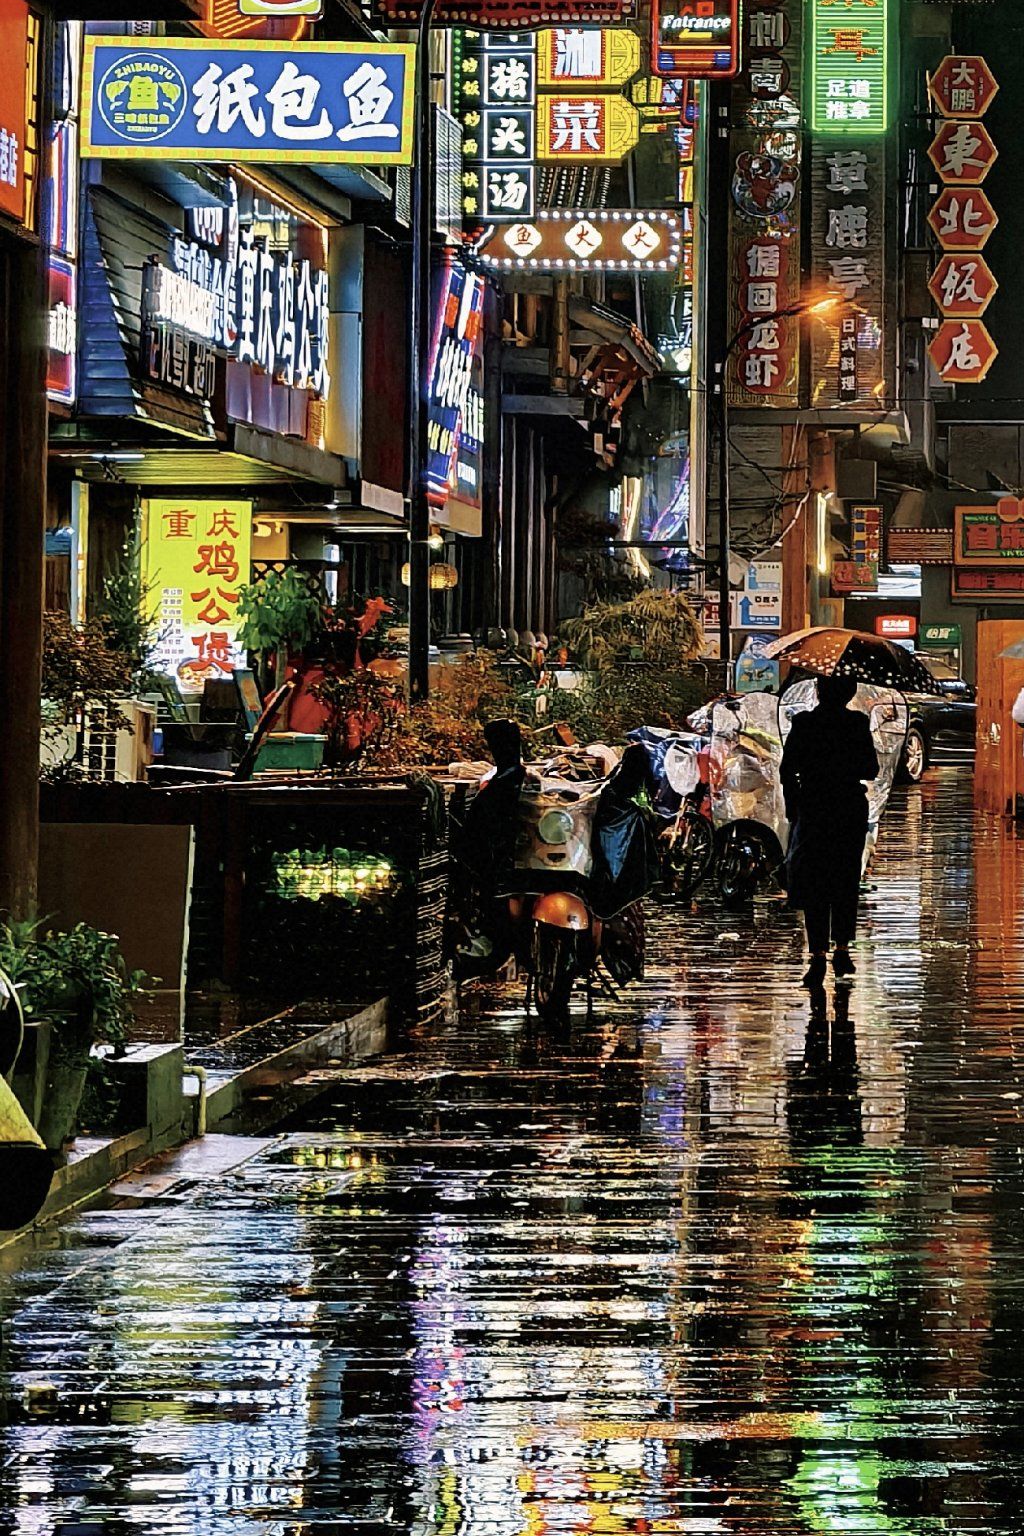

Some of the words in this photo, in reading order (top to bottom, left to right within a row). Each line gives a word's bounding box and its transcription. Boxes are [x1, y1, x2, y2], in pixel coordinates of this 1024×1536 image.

[662, 14, 732, 29] Entrance
[113, 62, 176, 81] ZHIBAOYU
[191, 61, 400, 142] 纸包鱼
[951, 61, 976, 111] 大鹏
[489, 58, 530, 210] 猪头汤
[825, 100, 871, 120] 推拿
[238, 223, 332, 402] 重庆鸡公煲
[841, 318, 857, 392] 日式料理
[161, 508, 240, 539] 重庆
[189, 540, 240, 674] 鸡公煲
